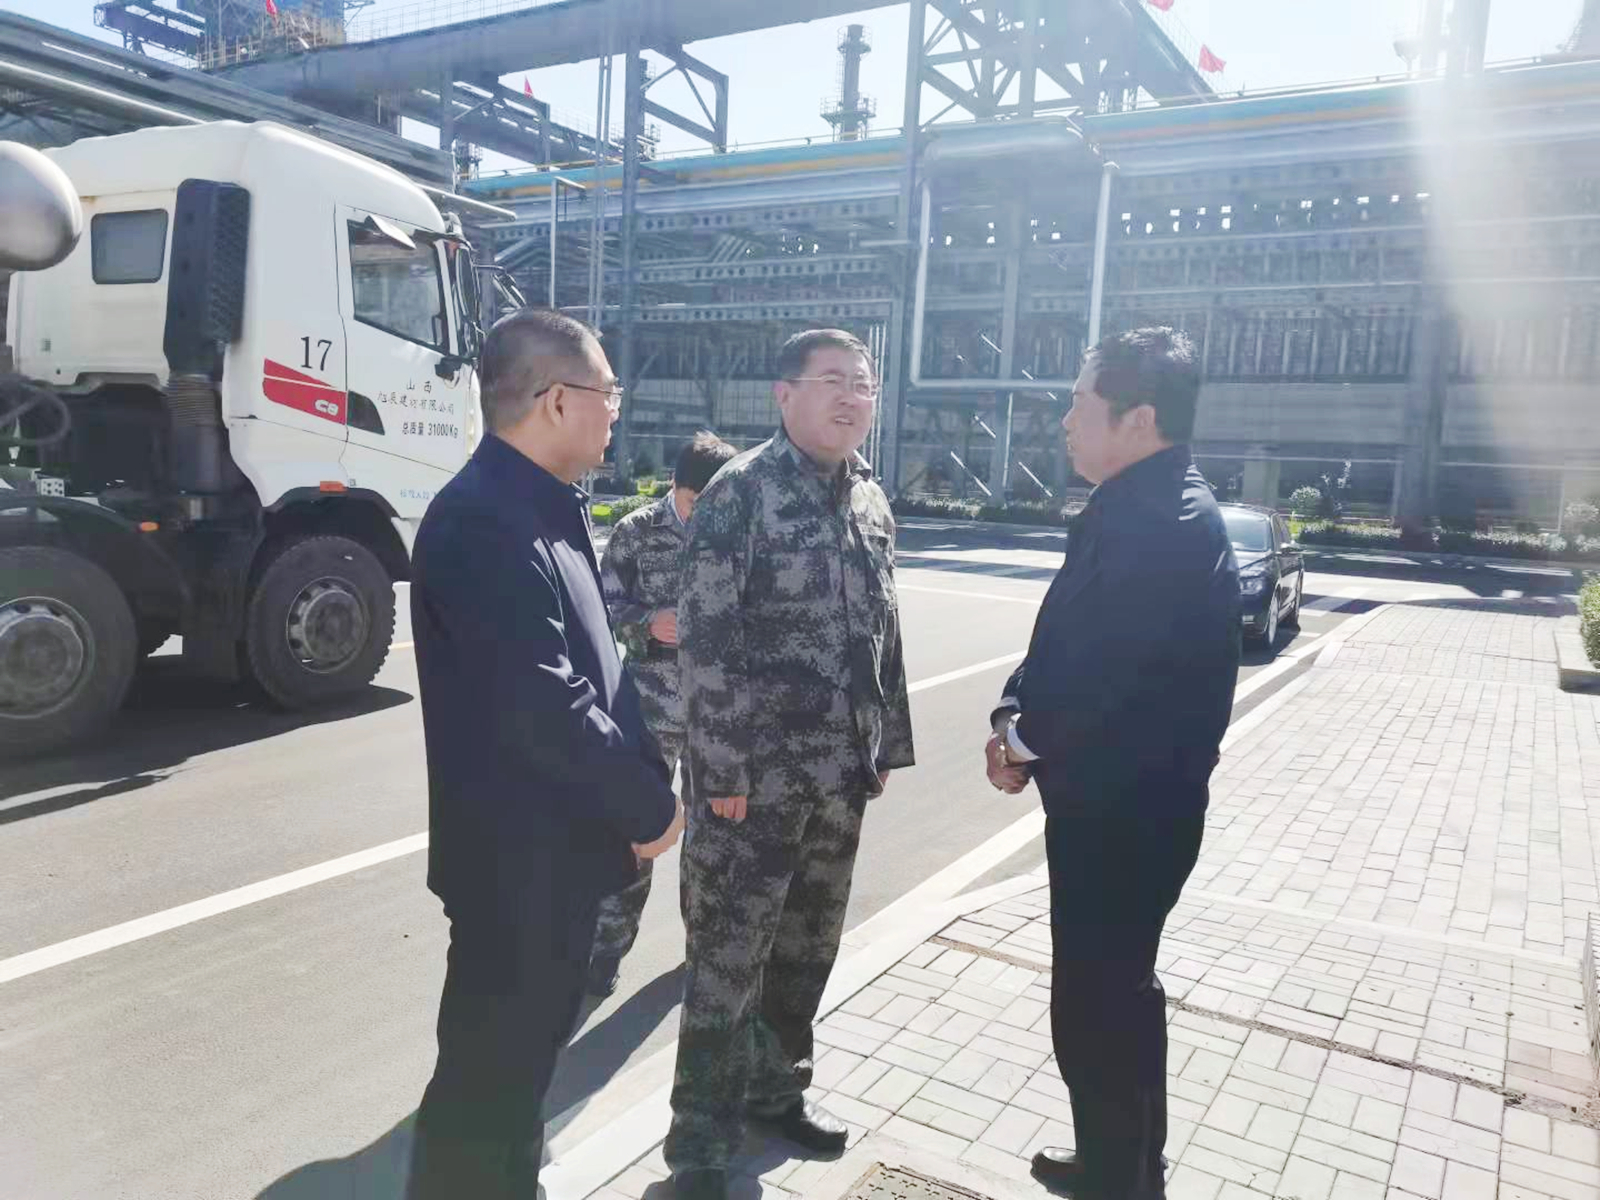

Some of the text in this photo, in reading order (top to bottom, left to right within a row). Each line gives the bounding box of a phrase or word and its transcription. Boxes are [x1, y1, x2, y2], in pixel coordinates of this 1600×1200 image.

[300, 336, 333, 372] 17
[406, 376, 433, 394] 山西
[402, 421, 425, 436] 总质量
